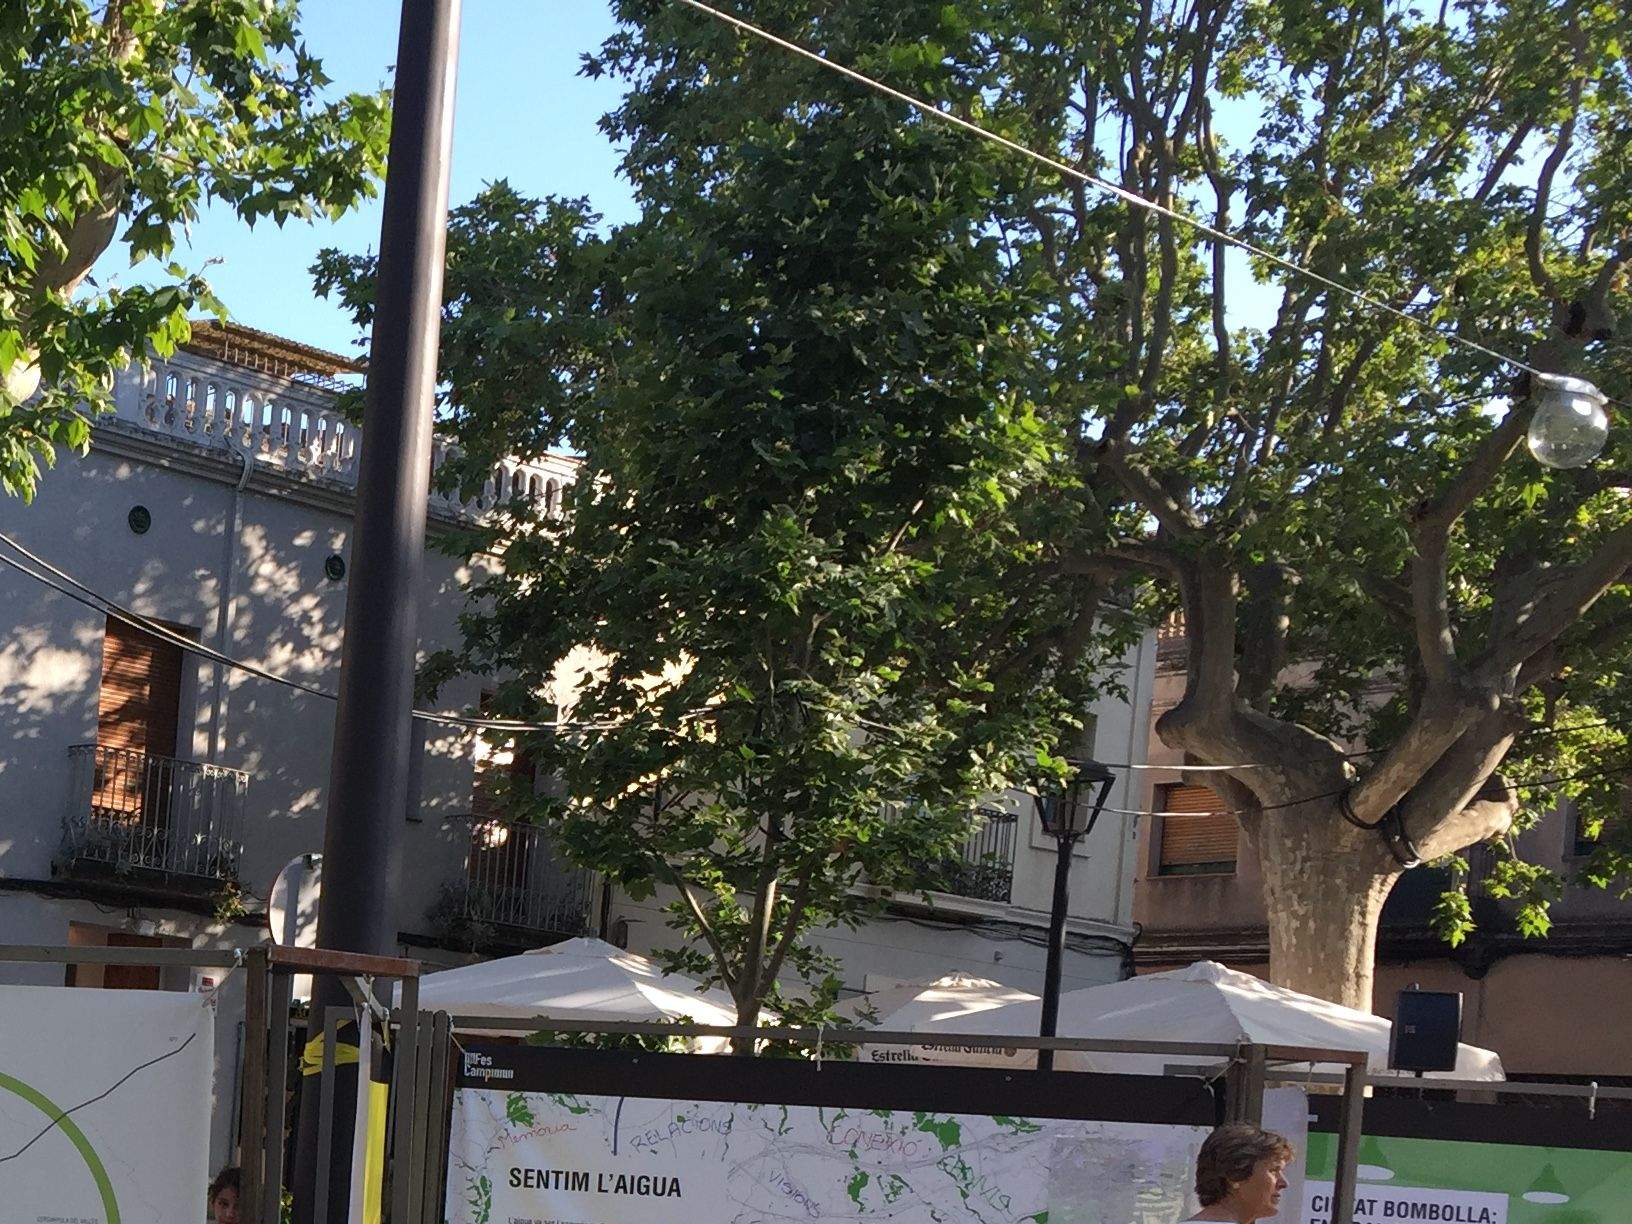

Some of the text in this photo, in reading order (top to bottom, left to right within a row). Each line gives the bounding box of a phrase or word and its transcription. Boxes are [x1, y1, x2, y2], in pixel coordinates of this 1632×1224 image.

[508, 1167, 682, 1198] SENTIM L'AIGUA
[1311, 1195, 1497, 1224] CIAT BOMBOLLA:
